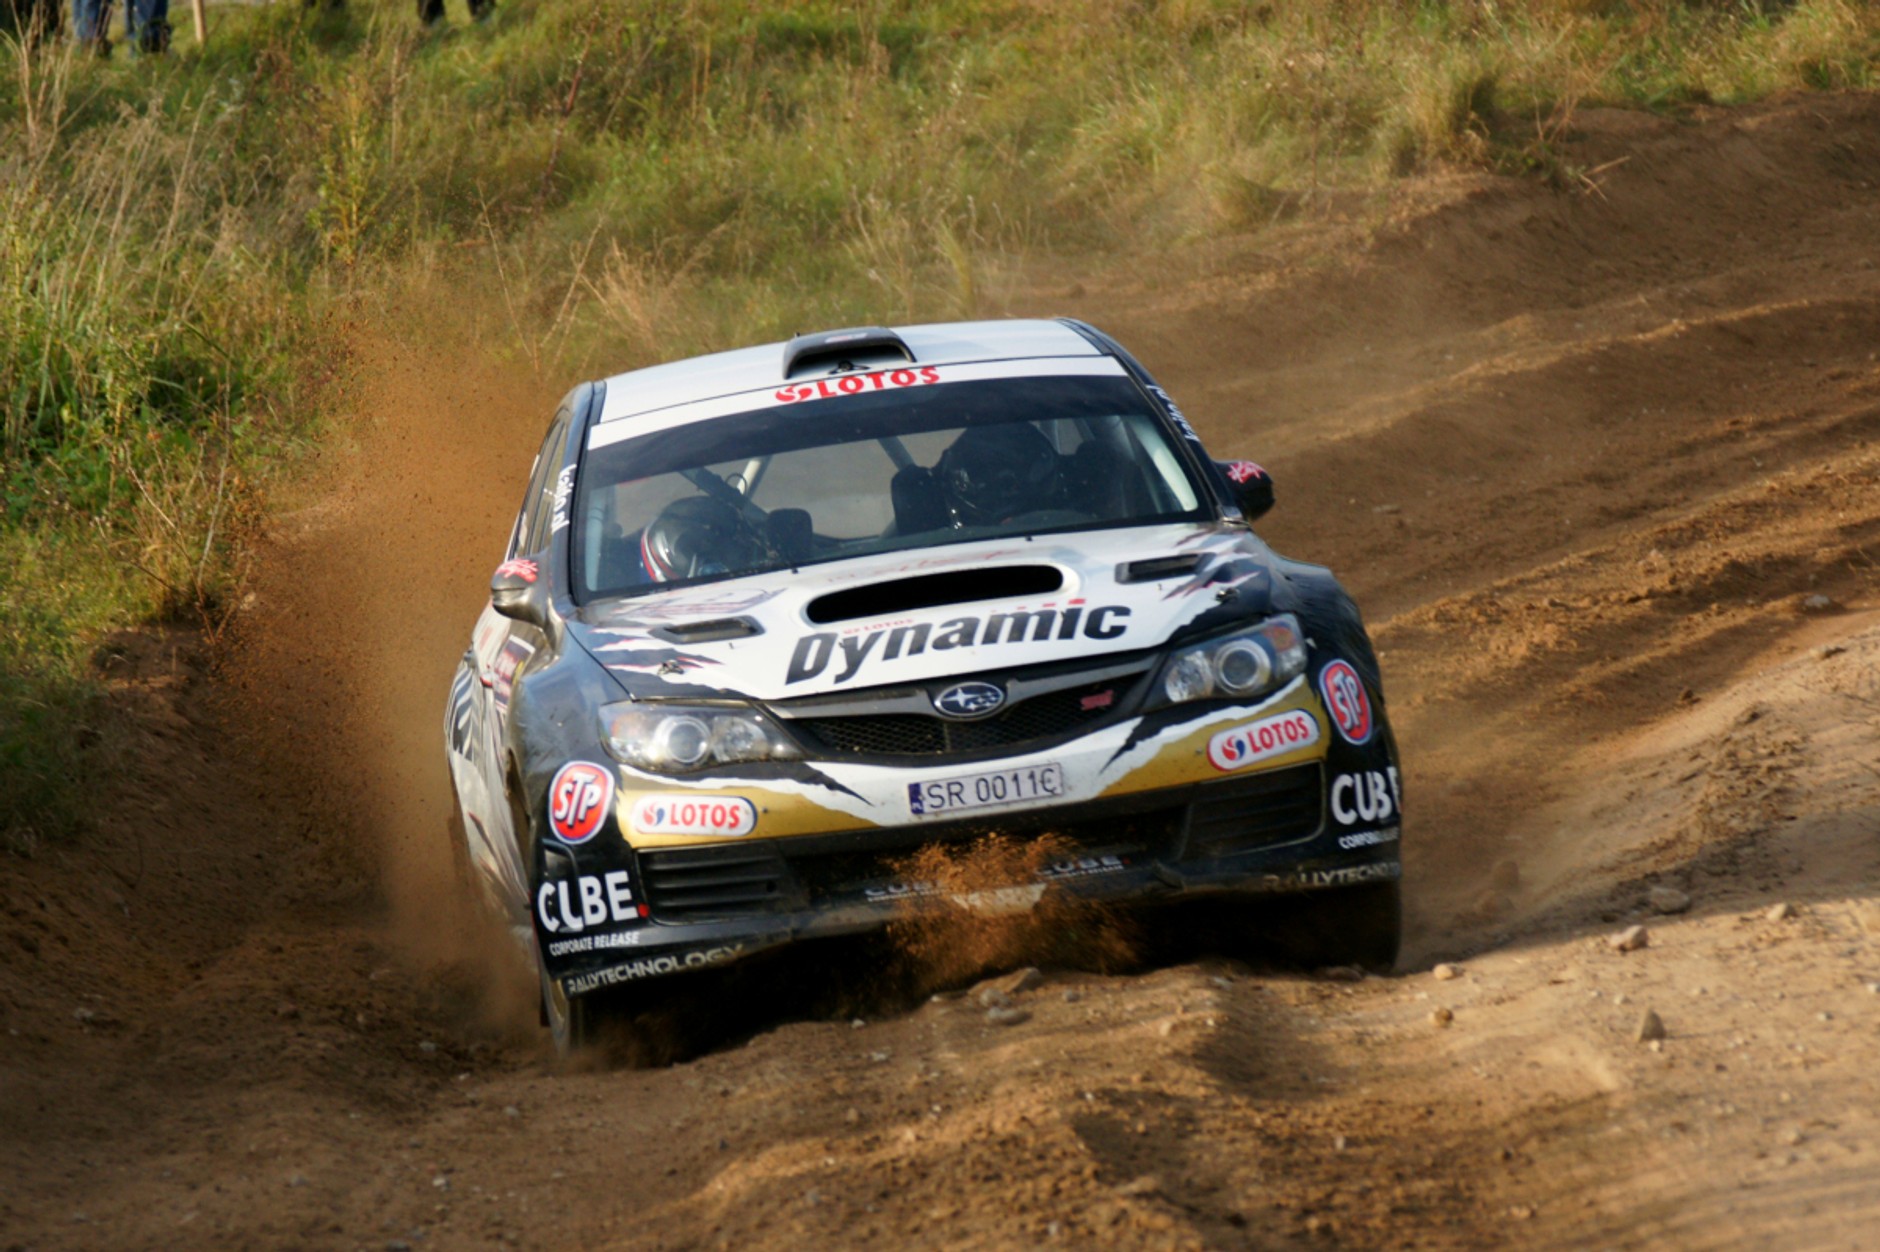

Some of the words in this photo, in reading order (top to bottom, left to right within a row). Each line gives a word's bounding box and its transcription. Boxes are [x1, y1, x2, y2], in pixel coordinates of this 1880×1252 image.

[817, 366, 940, 398] LOTOS
[785, 598, 1132, 686] Dynamic
[1334, 668, 1362, 730] STP
[1246, 716, 1310, 754] LOTOS
[554, 771, 601, 828] STP
[927, 780, 966, 809] SR
[669, 803, 741, 830] LOTOS
[594, 930, 641, 950] RELEASE
